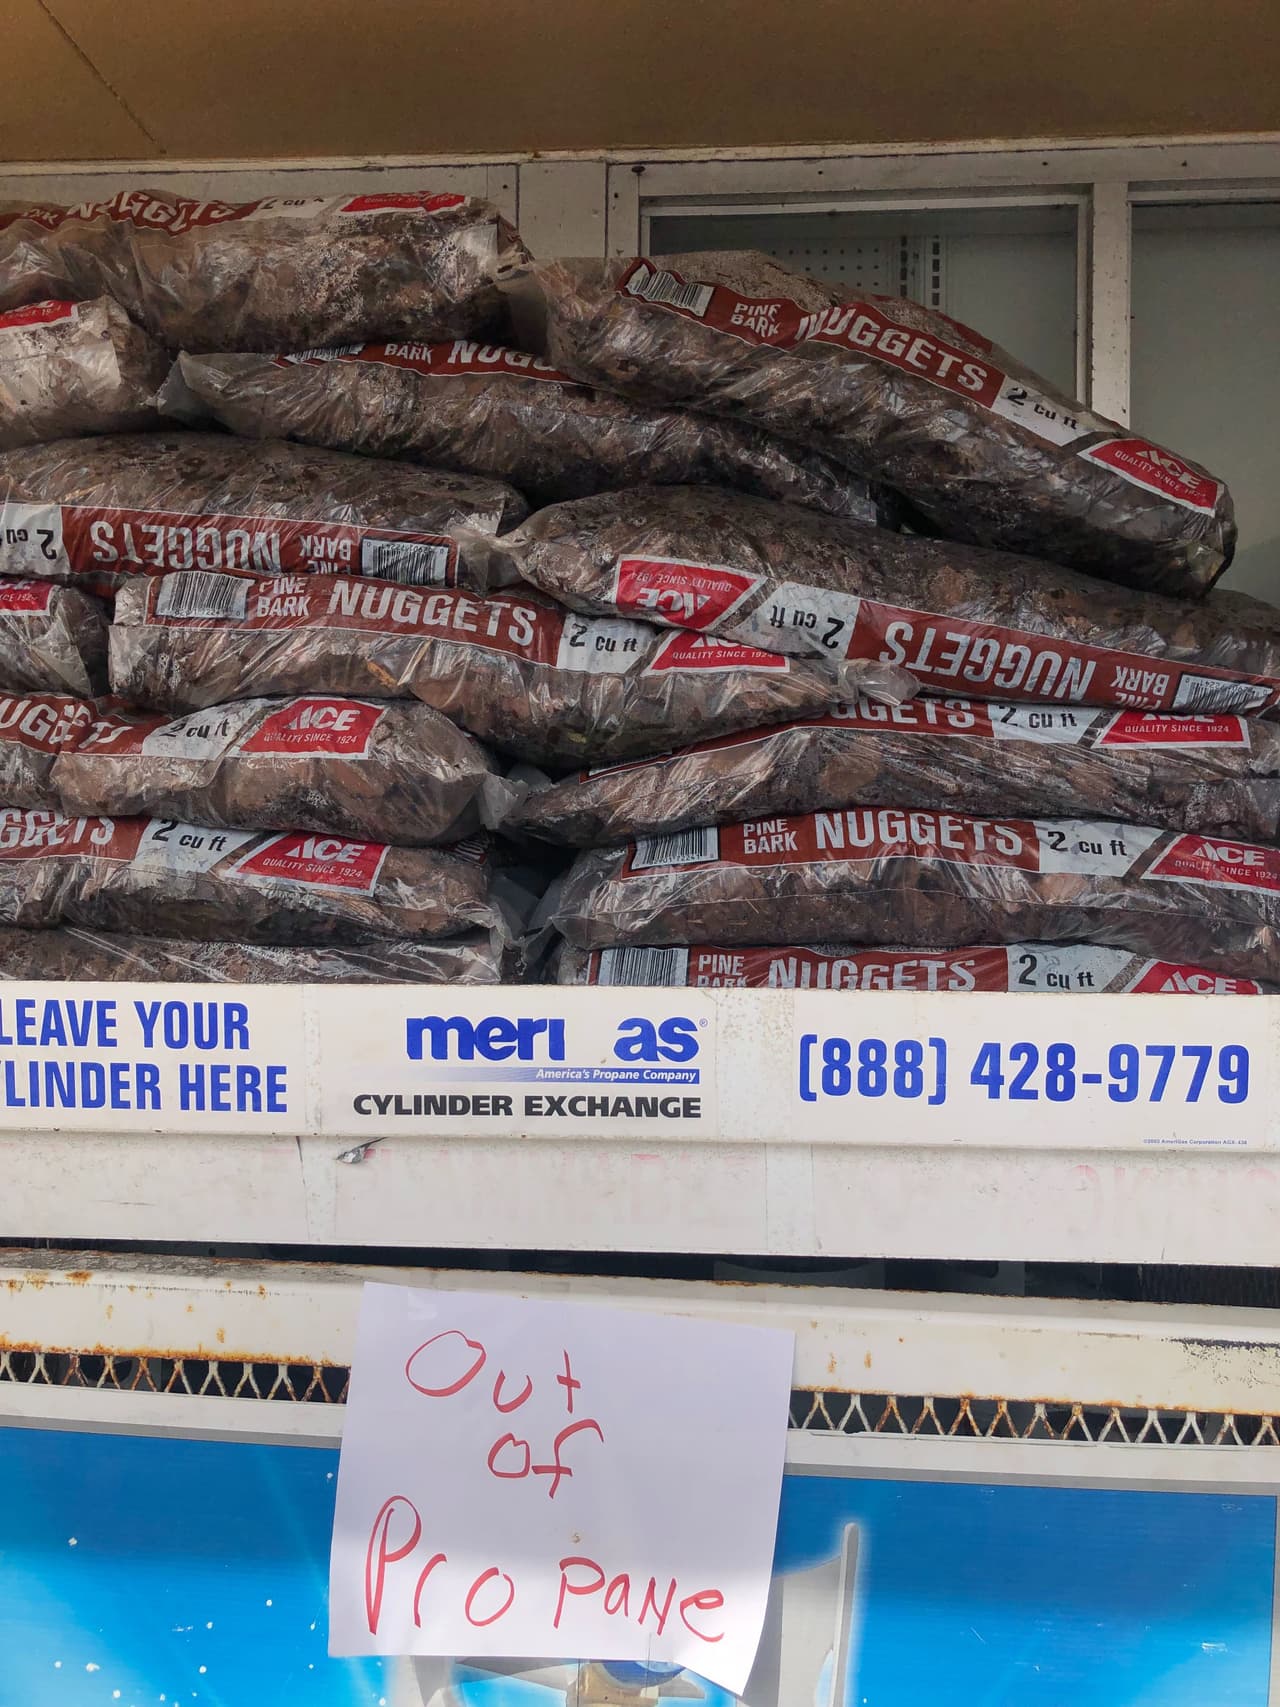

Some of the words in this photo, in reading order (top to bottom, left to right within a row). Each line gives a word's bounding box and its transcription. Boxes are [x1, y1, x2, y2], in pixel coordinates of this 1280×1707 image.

[733, 302, 782, 322] PINE
[730, 314, 782, 338] BARK
[384, 343, 433, 364] BARK
[795, 306, 988, 392] NUGGETS
[1006, 387, 1028, 406] 2
[1033, 402, 1057, 421] cu
[1114, 450, 1155, 473] QUALITY
[1154, 470, 1180, 492] SINCE
[1135, 450, 1201, 489] ACE
[6, 528, 29, 545] cu
[36, 528, 57, 560] 2
[89, 520, 282, 577] NUGGETS
[299, 535, 353, 561] BARK
[656, 573, 687, 586] SINCE
[692, 577, 732, 593] QUALITY
[256, 596, 313, 618] BARK
[326, 580, 537, 647] NUGGETS
[637, 587, 712, 621] ACE
[769, 605, 787, 628] ft
[792, 610, 818, 630] cu
[821, 617, 845, 649] 2
[569, 622, 589, 648] 2
[595, 636, 617, 652] cu
[622, 636, 638, 653] ft
[672, 651, 714, 660] QUALITY
[716, 651, 747, 660] SINCE
[879, 621, 1097, 700] NUGGETS
[1110, 665, 1171, 698] BARK
[283, 705, 361, 732] ACE
[998, 704, 1019, 727] 2
[1028, 712, 1053, 729] cu
[1060, 712, 1078, 728] ft
[1124, 723, 1168, 734] QUALITY
[1171, 723, 1202, 733] SINCE
[1206, 724, 1230, 733] 1924
[159, 723, 186, 739] 2
[186, 725, 209, 739] cu
[263, 732, 304, 745] QUALITY
[304, 732, 333, 743] SINCE
[336, 735, 359, 745] 1924
[152, 818, 179, 843] 2
[178, 833, 206, 850] cu
[208, 835, 229, 853] ft
[743, 818, 788, 838] PINE
[815, 810, 1023, 856] NUGGETS
[286, 836, 367, 865] ACE
[744, 831, 799, 855] BARK
[1047, 830, 1069, 852] 2
[1078, 840, 1104, 856] cu
[1110, 839, 1128, 857] ft
[1192, 842, 1265, 866] ACE
[262, 857, 305, 871] QUALITY
[305, 863, 336, 875] SINCE
[339, 866, 364, 879] 1924
[1174, 859, 1217, 874] QUALITY
[1219, 866, 1252, 877] SINCE
[699, 953, 746, 976] PINE
[768, 956, 977, 992] NUGGETS
[1018, 953, 1038, 987] 2
[1046, 971, 1071, 990] cu
[1076, 971, 1096, 988] ft
[1159, 970, 1239, 994] ACE
[0, 998, 118, 1048] LEAVE
[134, 1000, 250, 1050] YOUR
[536, 1067, 591, 1081] America's
[592, 1068, 640, 1083] Propane
[643, 1068, 698, 1084] Company
[970, 1042, 1250, 1104] 428-9779
[0, 1060, 162, 1110] LINDER
[179, 1063, 288, 1113] HERE
[353, 1094, 522, 1117] CYLINDER
[524, 1095, 702, 1118] EXCHANGE
[405, 1329, 581, 1414] Out
